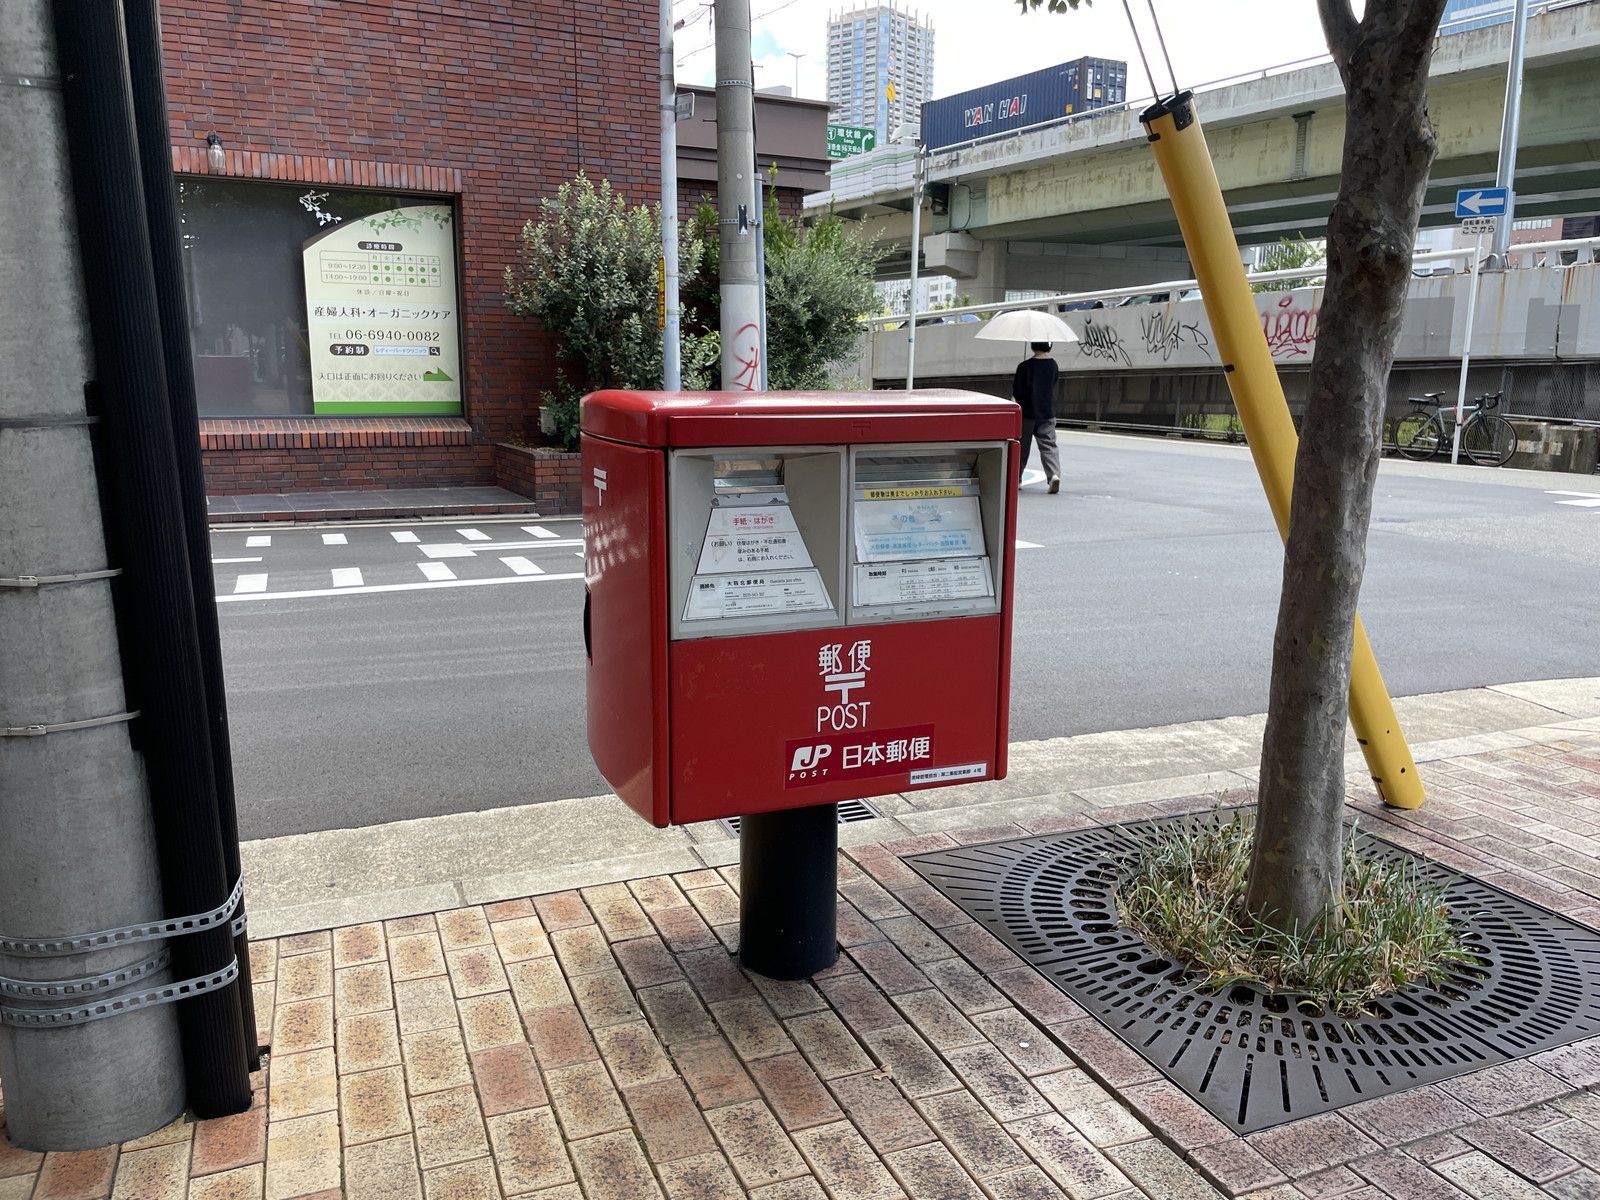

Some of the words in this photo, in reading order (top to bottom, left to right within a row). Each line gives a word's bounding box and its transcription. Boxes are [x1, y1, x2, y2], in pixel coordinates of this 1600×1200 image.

[964, 103, 994, 128] WAN
[998, 94, 1028, 120] HAI
[837, 128, 861, 139] 環状線
[1462, 225, 1495, 235] ここから
[365, 242, 395, 250] 診療時間
[314, 306, 451, 320] 産婦人科・オーガニックケア
[329, 332, 343, 340] TEL
[345, 329, 440, 342] 06-6940-0082
[334, 345, 365, 355] 予約制
[319, 372, 422, 381] 入口は正面にお回りください
[732, 517, 774, 526] 手紙・はがき
[818, 639, 872, 676] 郵便
[817, 701, 871, 733] POST
[842, 736, 930, 769] 日本郵便
[789, 768, 828, 780] POST
